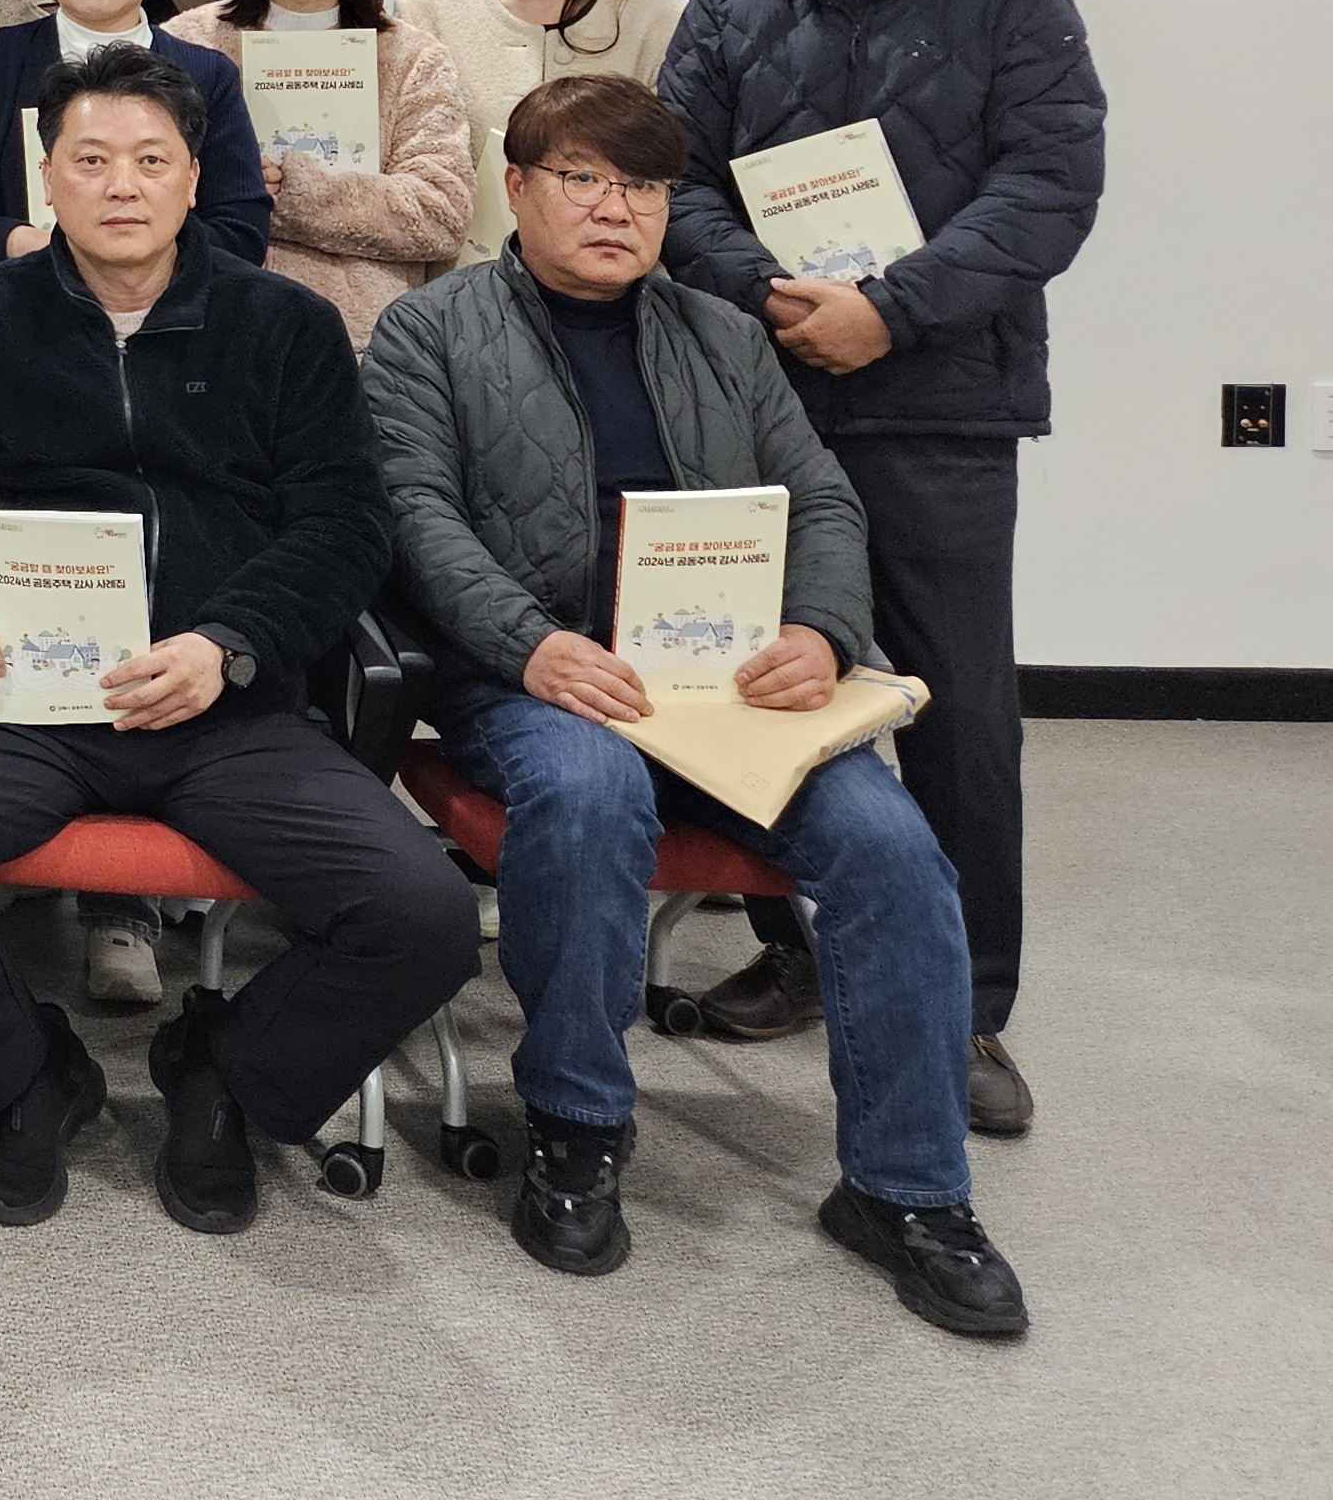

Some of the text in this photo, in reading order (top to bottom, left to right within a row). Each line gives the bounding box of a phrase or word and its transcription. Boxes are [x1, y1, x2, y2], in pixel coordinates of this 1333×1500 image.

[637, 556, 674, 566] 2024년
[676, 555, 716, 566] 공동주택
[32, 577, 72, 588] 공동주택
